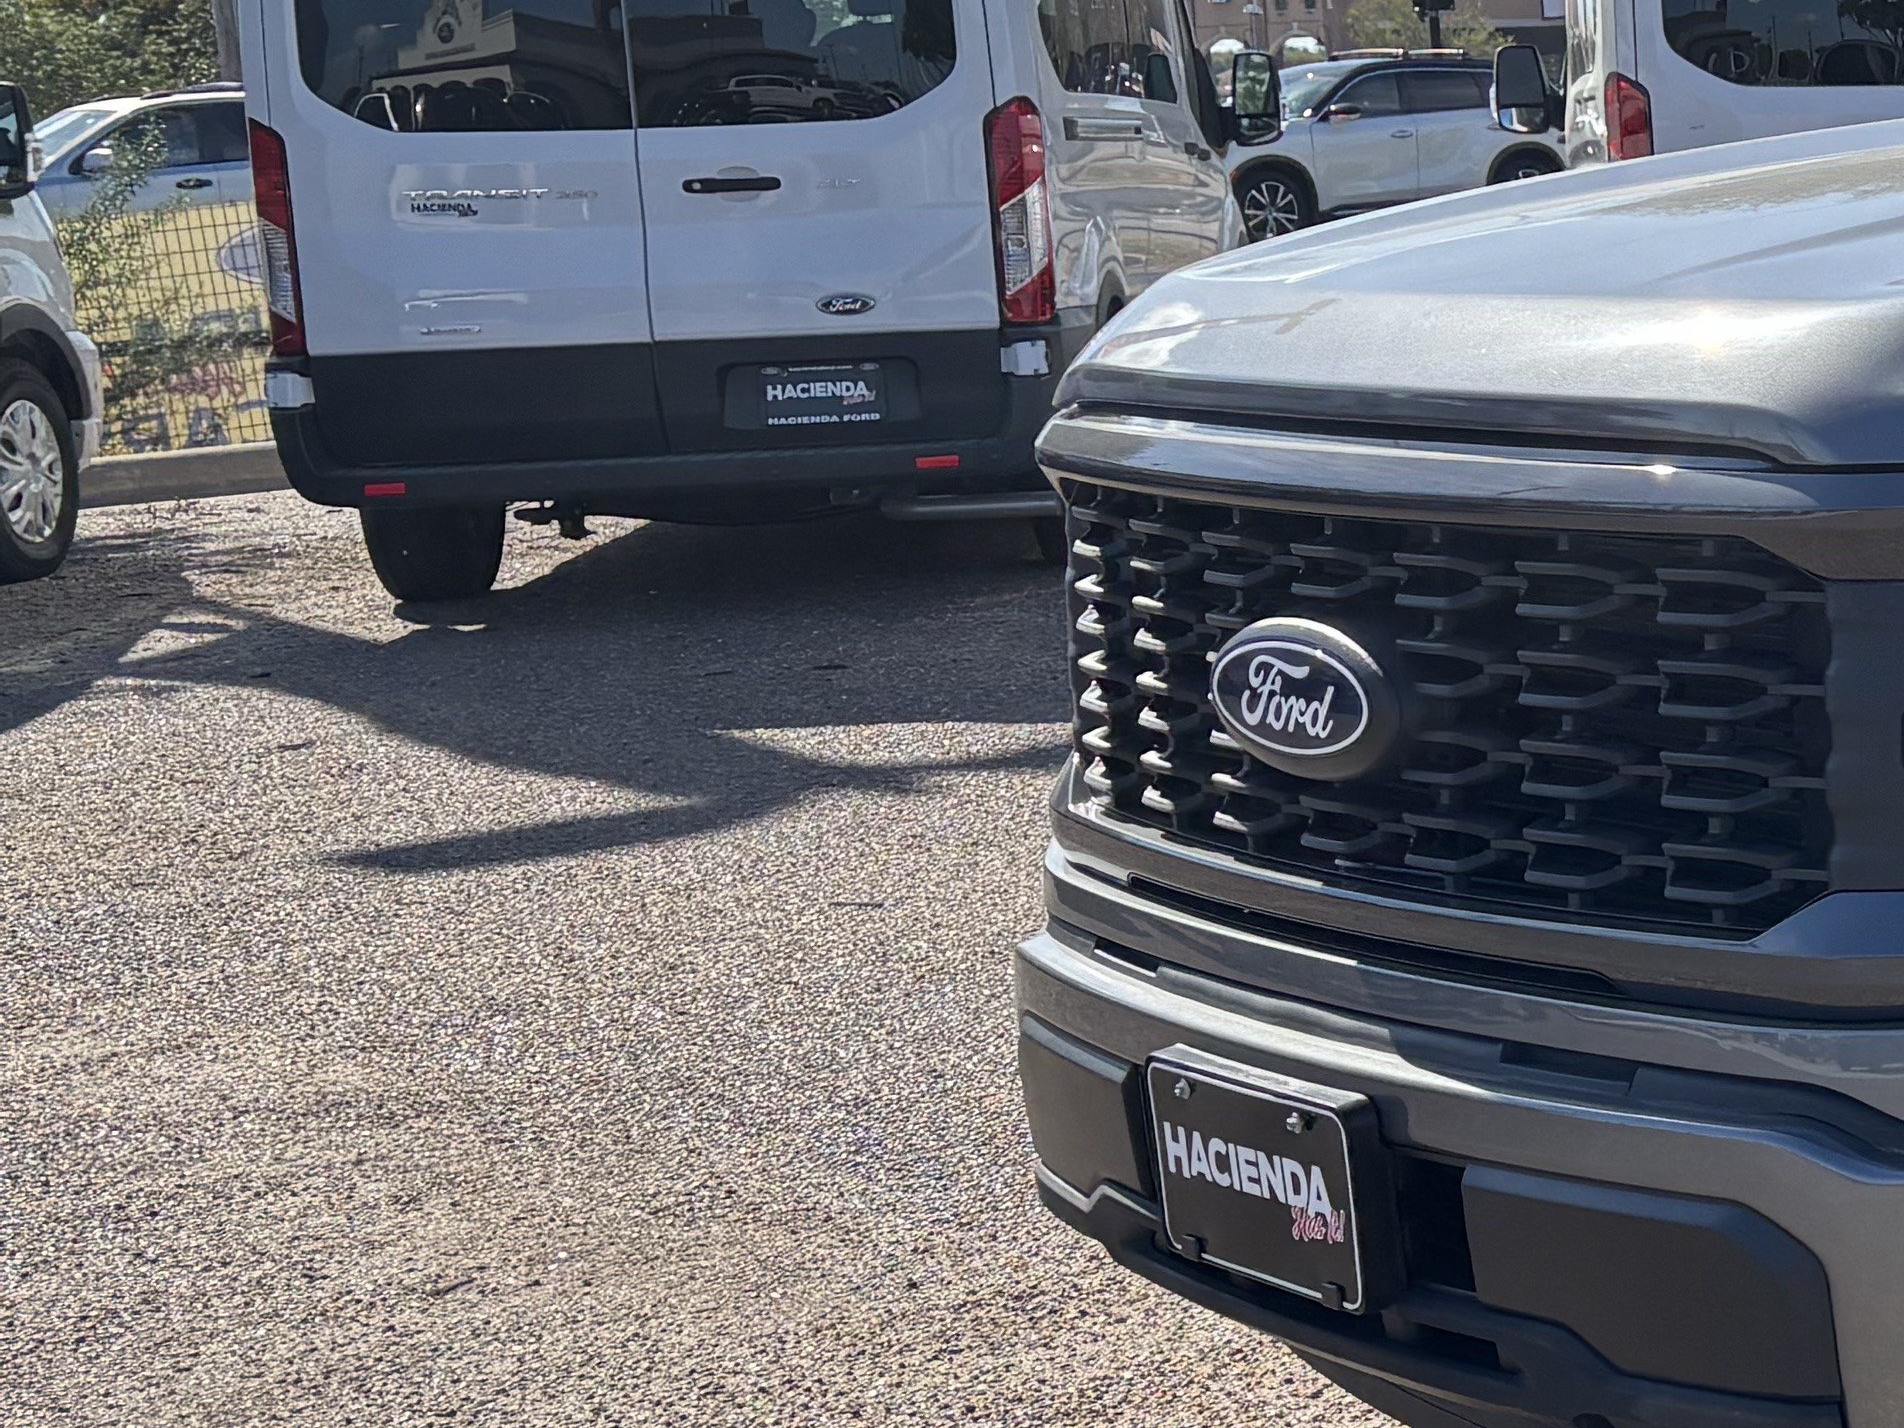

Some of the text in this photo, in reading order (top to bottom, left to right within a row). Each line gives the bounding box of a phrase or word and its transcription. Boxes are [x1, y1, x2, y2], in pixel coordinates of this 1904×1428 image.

[829, 298, 863, 312] Ford
[766, 380, 869, 402] HACIENDA
[767, 413, 881, 426] HACIENDA FORD
[1240, 653, 1336, 739] Ford
[1162, 1121, 1334, 1223] HACIENDA
